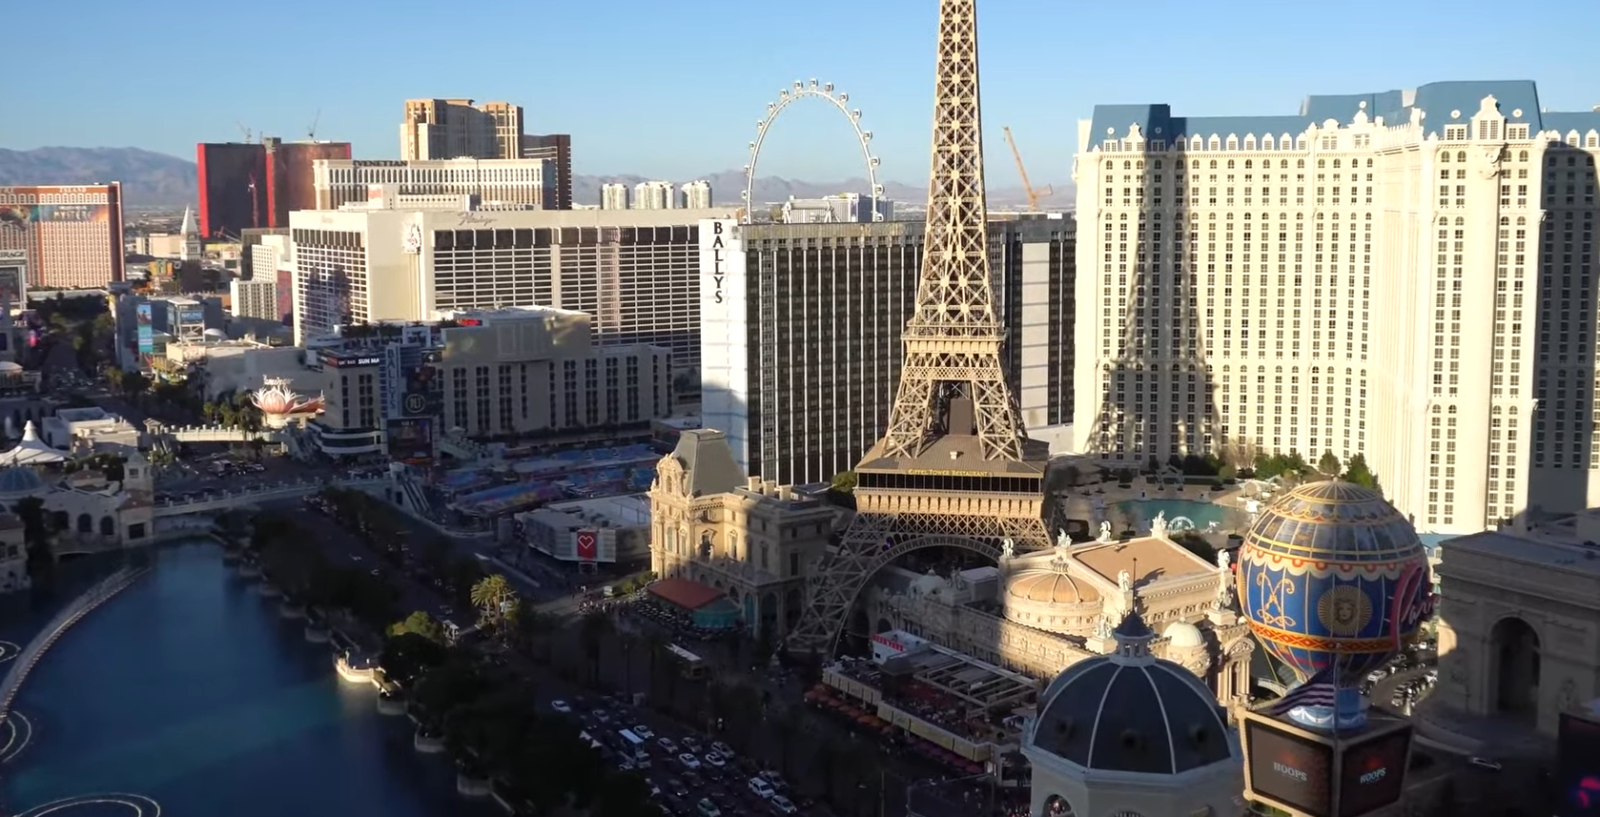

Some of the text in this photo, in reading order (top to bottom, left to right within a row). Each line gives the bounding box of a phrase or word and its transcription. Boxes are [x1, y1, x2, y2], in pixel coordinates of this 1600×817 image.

[712, 221, 725, 304] BALLYS
[387, 348, 396, 410] BALLYS
[951, 469, 988, 477] RESTAURANT
[1273, 762, 1307, 782] HOOPS
[1360, 767, 1386, 784] HOOPS
